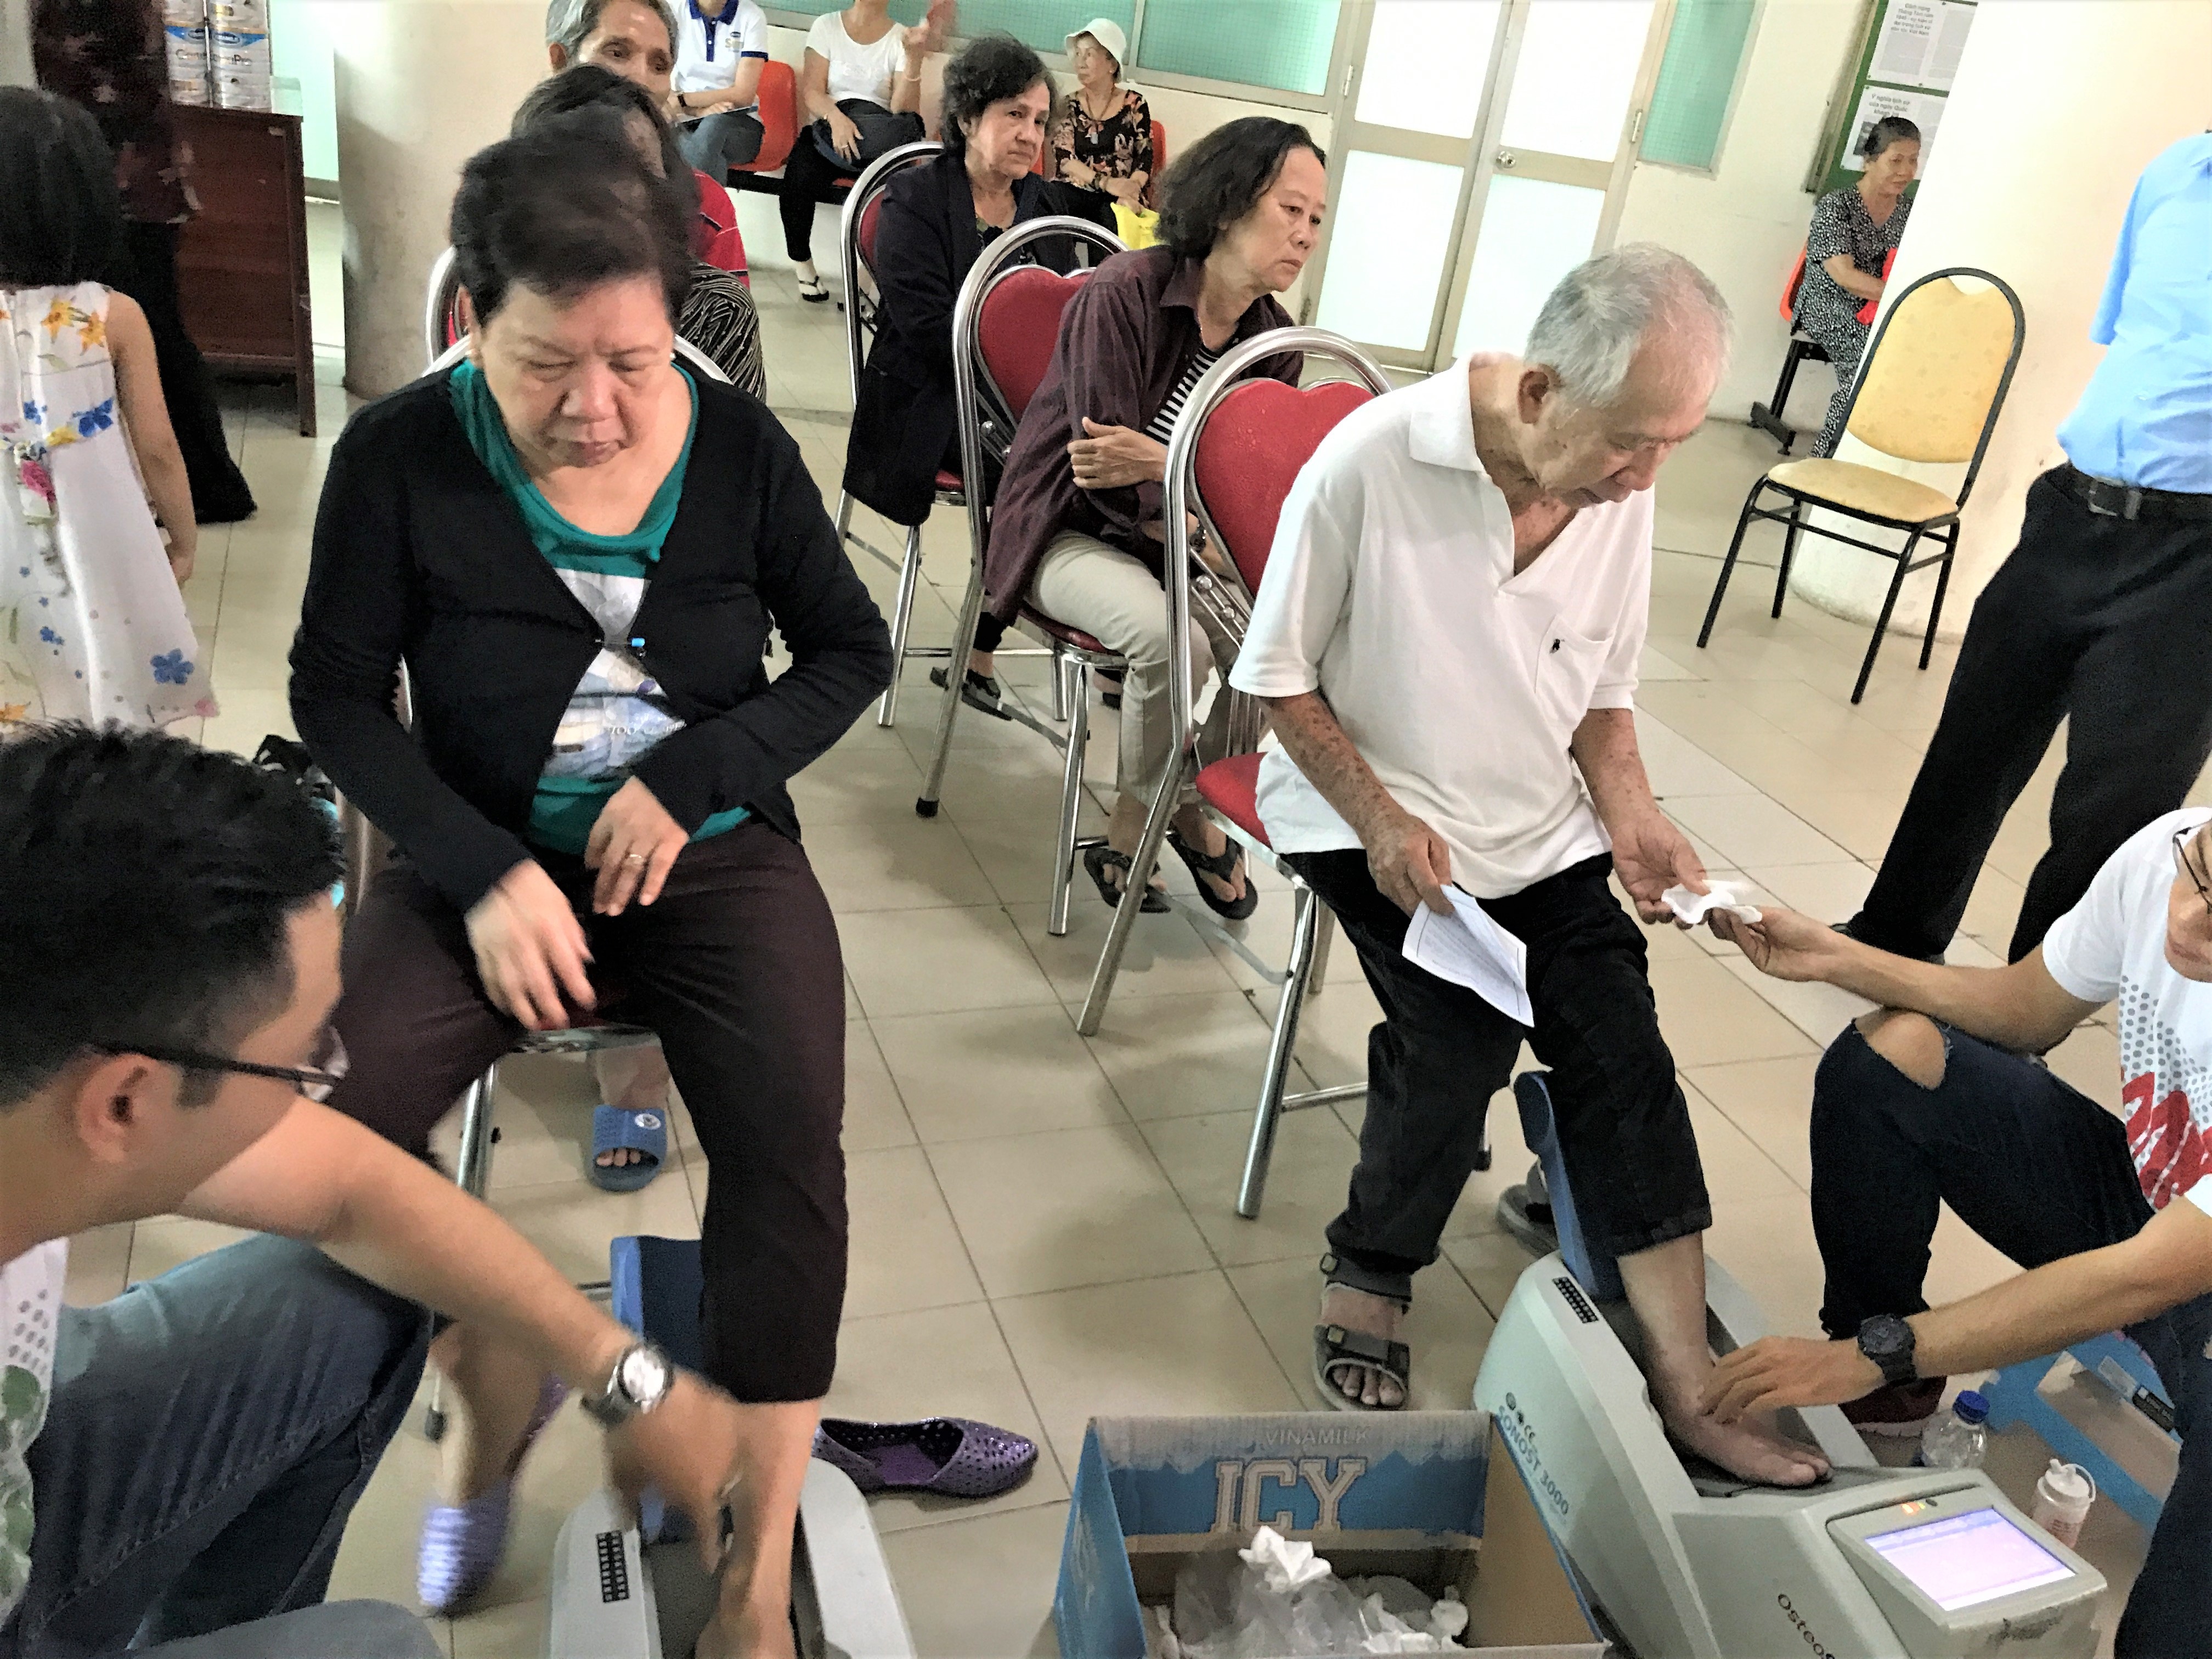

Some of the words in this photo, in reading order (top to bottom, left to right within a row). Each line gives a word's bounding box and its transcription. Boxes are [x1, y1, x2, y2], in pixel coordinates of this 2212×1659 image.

[1265, 1427, 1368, 1445] VINAMILK
[1499, 1405, 1542, 1472] SONOST
[1539, 1469, 1569, 1515] 3000
[1209, 1456, 1368, 1533] ICY
